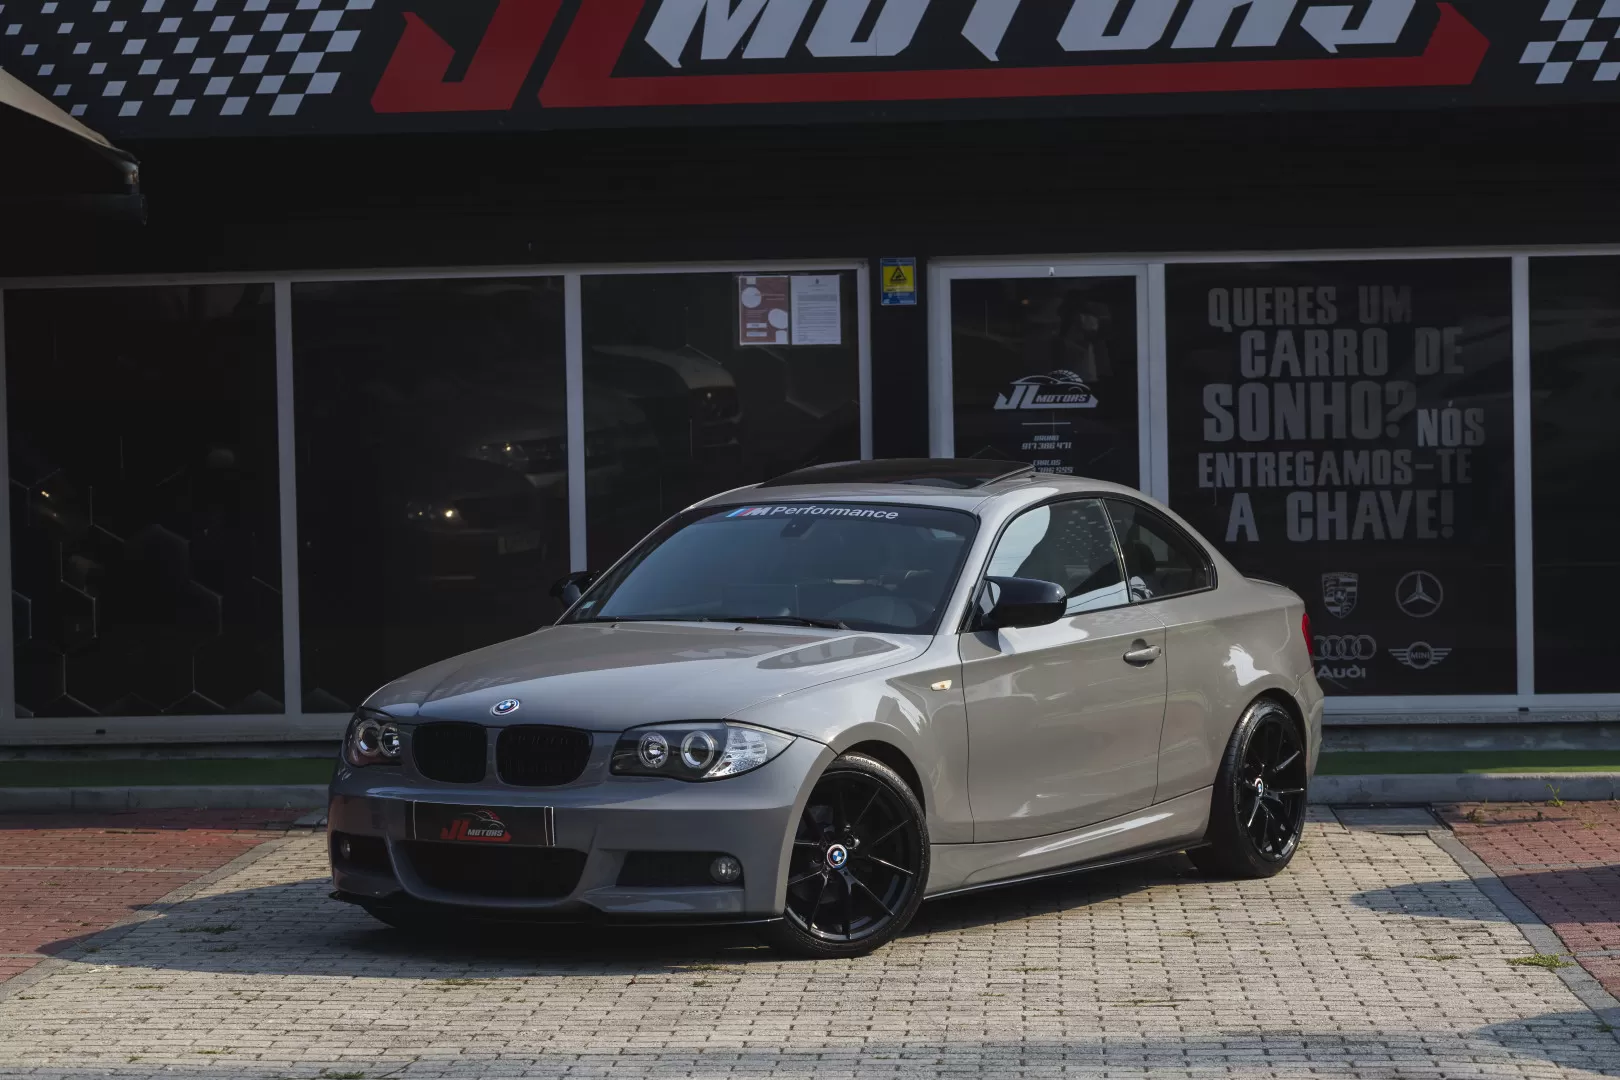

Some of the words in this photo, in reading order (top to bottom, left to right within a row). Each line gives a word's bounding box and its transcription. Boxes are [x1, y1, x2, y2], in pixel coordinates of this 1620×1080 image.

[1208, 285, 1337, 332] QUERES
[1357, 285, 1412, 324] UM
[1240, 328, 1388, 378] CARRO
[1415, 326, 1464, 375] DE
[1035, 394, 1087, 403] MOTORS
[1203, 380, 1417, 442] SONHO?
[1417, 400, 1486, 447] NÓS
[1198, 448, 1472, 488] ENTREGAMOS-TE
[770, 505, 899, 520] Performance
[1225, 492, 1260, 542] A
[1286, 489, 1455, 542] CHAVE!
[467, 828, 503, 837] MOTORS
